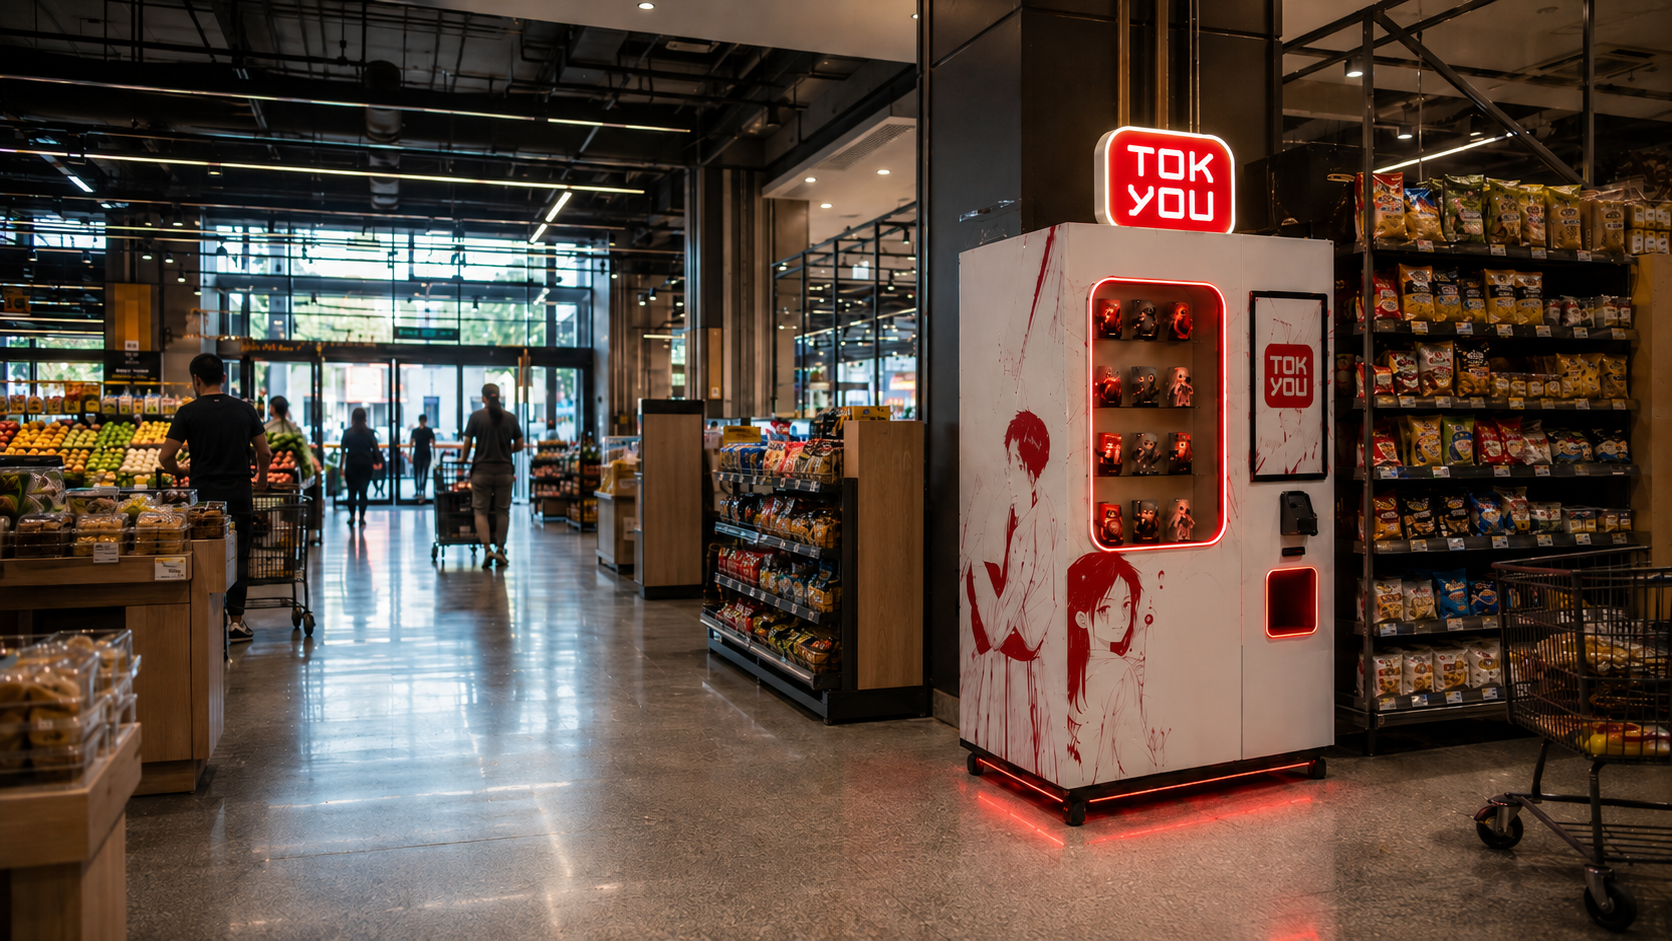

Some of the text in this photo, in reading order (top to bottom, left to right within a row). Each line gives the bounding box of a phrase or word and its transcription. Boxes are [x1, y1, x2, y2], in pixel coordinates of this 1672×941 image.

[1127, 144, 1214, 183] TOK
[1128, 184, 1214, 221] YOU
[1269, 355, 1307, 375] TOK
[1270, 377, 1307, 397] YOU
